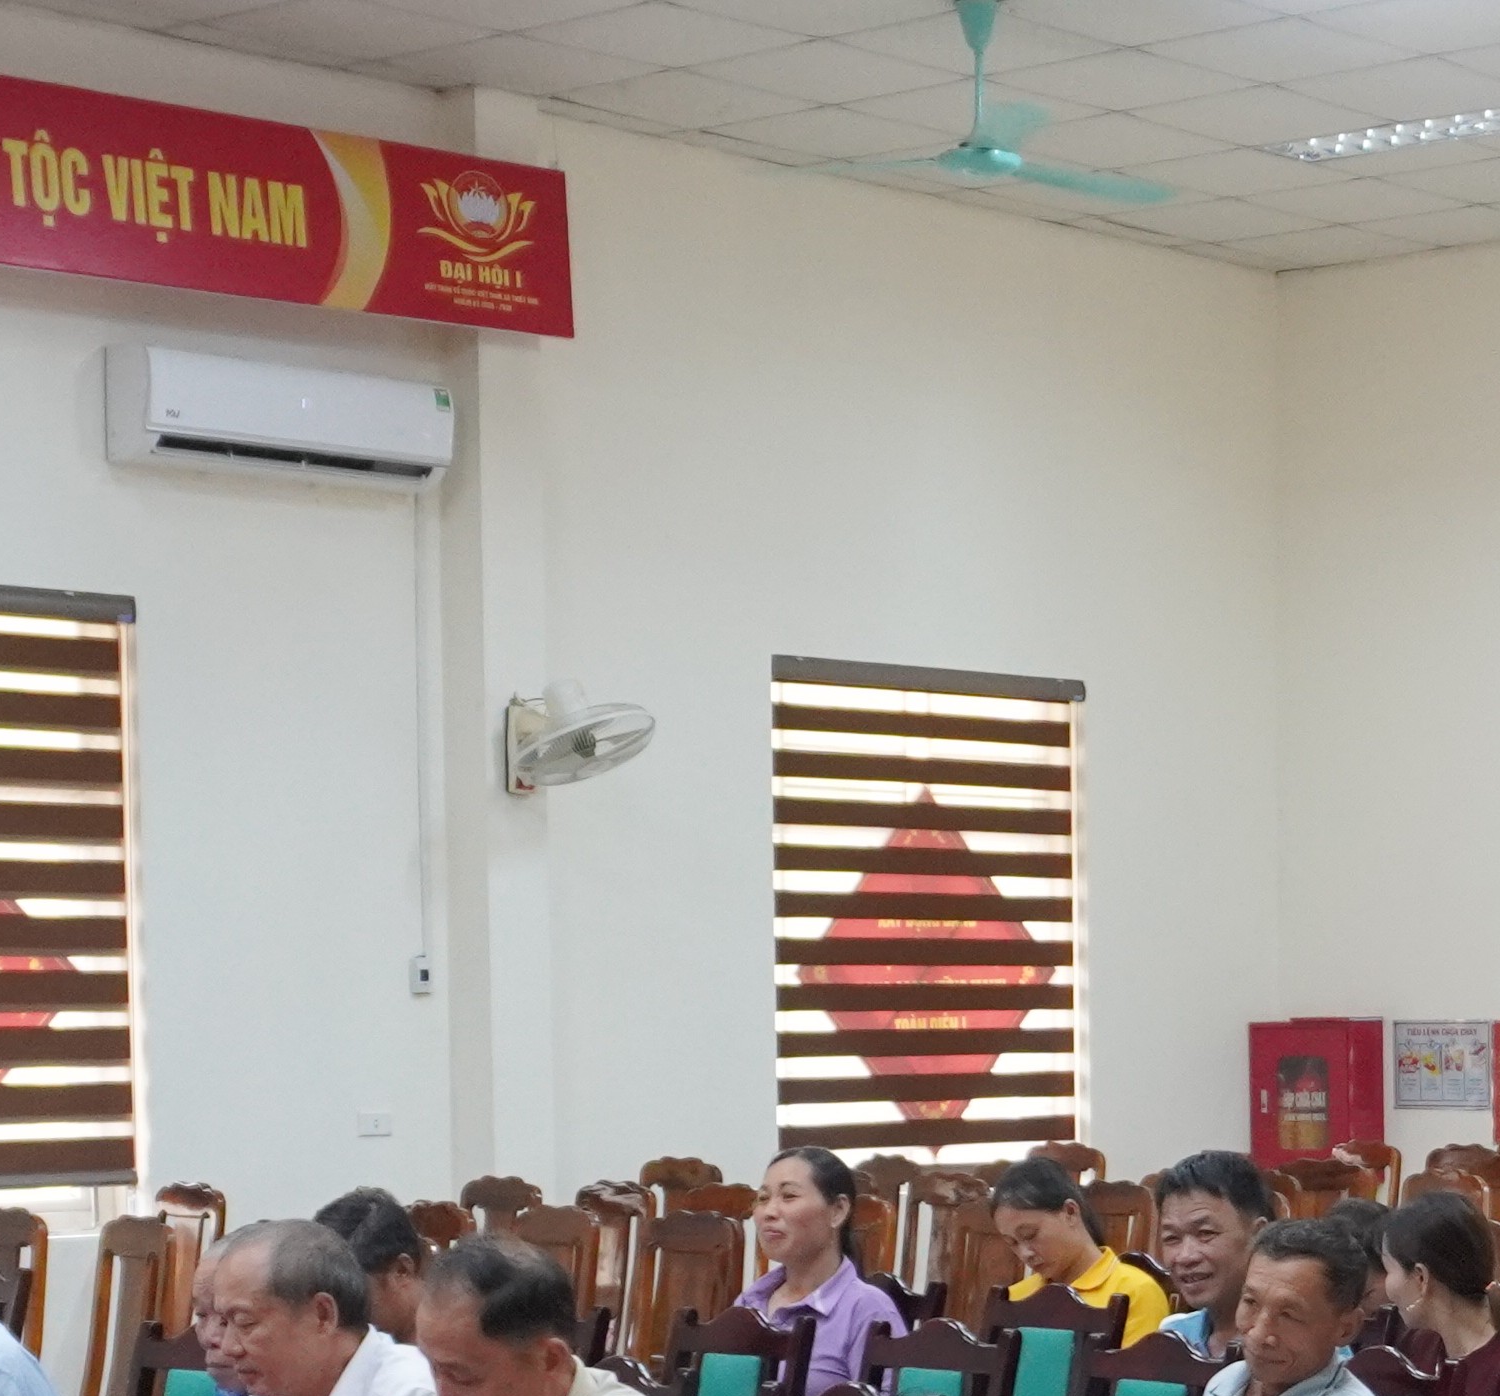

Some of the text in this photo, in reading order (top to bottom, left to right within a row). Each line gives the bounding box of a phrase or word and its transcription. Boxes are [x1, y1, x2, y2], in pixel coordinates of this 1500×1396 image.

[2, 129, 91, 229] TỘC
[101, 148, 194, 244] VIỆT
[207, 171, 307, 248] NAM
[439, 260, 473, 284] ĐẠI
[478, 264, 510, 289] HỘI
